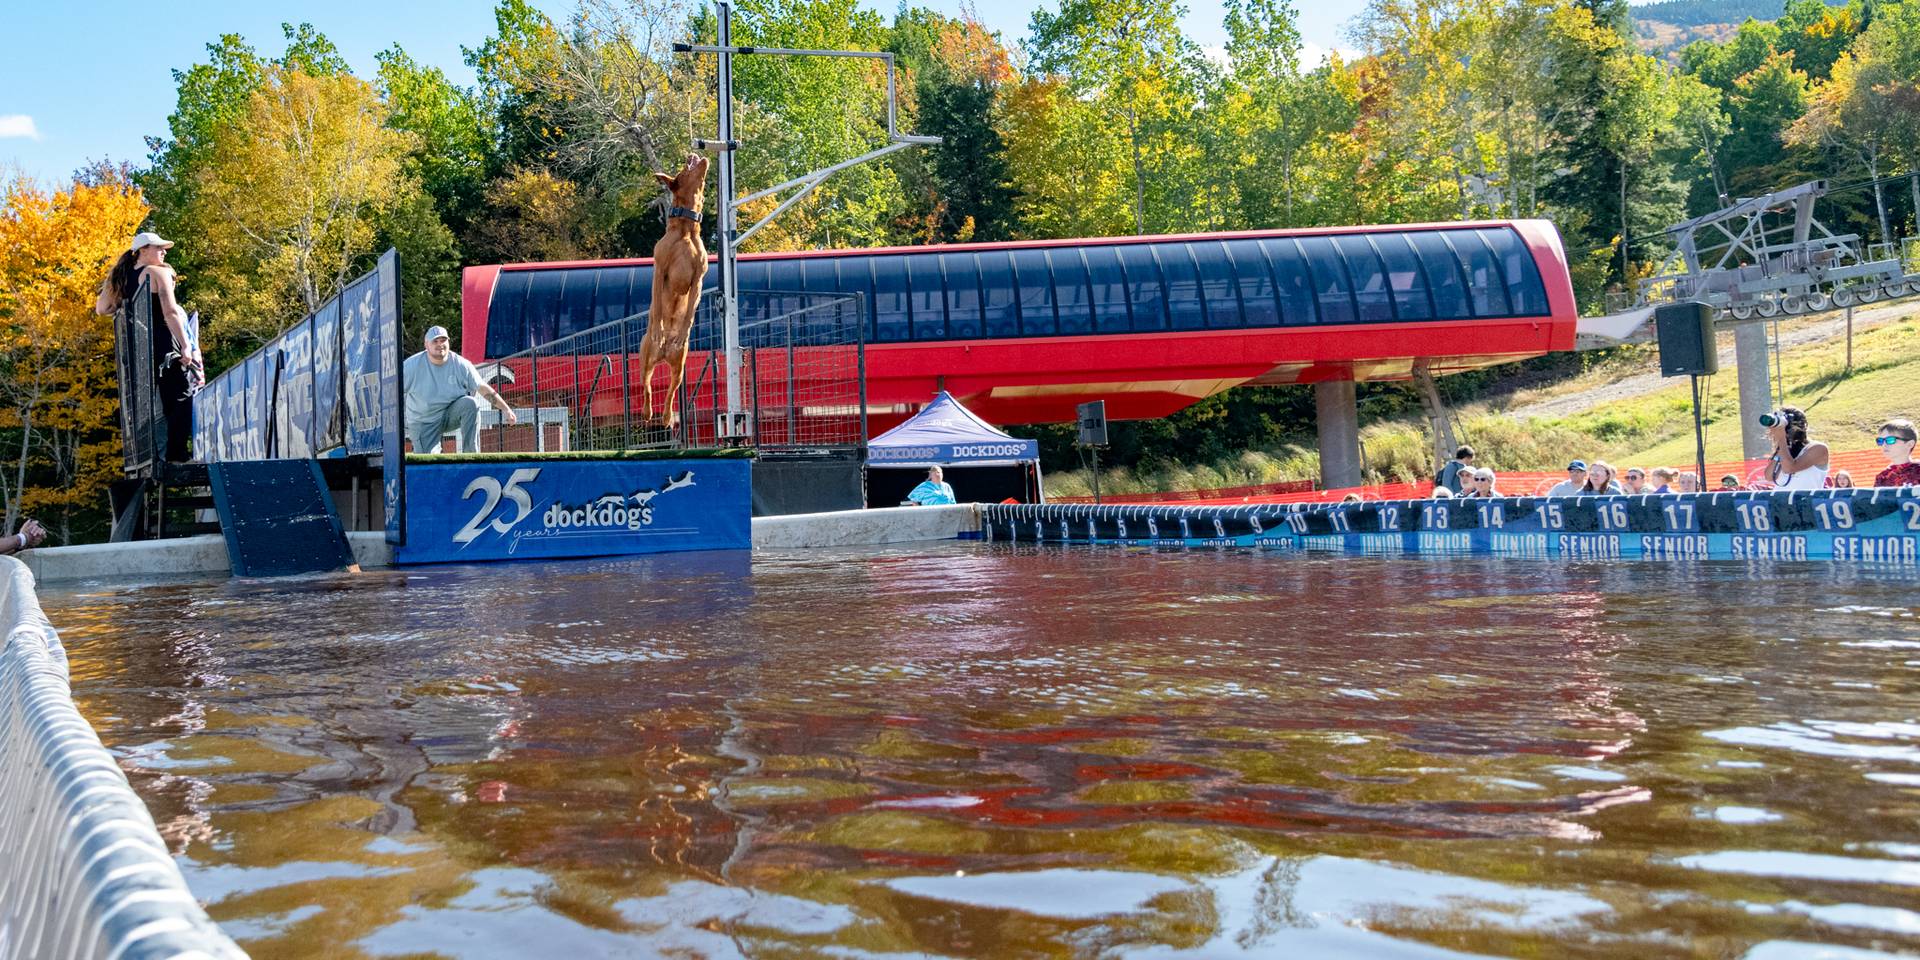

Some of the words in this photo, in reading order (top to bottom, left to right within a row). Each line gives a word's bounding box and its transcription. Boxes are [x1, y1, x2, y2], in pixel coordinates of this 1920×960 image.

[452, 467, 542, 545] 25
[987, 523, 993, 538] 0
[1011, 523, 1016, 538] 1
[1036, 521, 1043, 538] 2
[1061, 521, 1069, 538] 3
[1089, 521, 1097, 537] 4
[1117, 519, 1127, 537] 5
[1148, 518, 1158, 536] 6
[1180, 519, 1189, 536] 7
[1213, 519, 1225, 537] 8
[1250, 515, 1263, 534] 9
[1286, 513, 1307, 533] 10
[1329, 511, 1349, 531] 11
[1378, 508, 1398, 529] 12
[1424, 506, 1448, 529] 13
[1479, 505, 1503, 528] 14
[1537, 505, 1563, 529] 15
[1598, 503, 1626, 529] 16
[1664, 504, 1694, 530] 17
[1737, 503, 1770, 531] 18
[1815, 501, 1853, 530] 19
[508, 528, 561, 555] years
[1419, 533, 1471, 549] JUNIOR
[1492, 534, 1547, 552] JUNIOR
[1559, 534, 1620, 554] SENIOR
[1642, 535, 1708, 554] SENIOR
[1733, 536, 1807, 558] SENIOR
[1833, 537, 1917, 560] SENIOR
